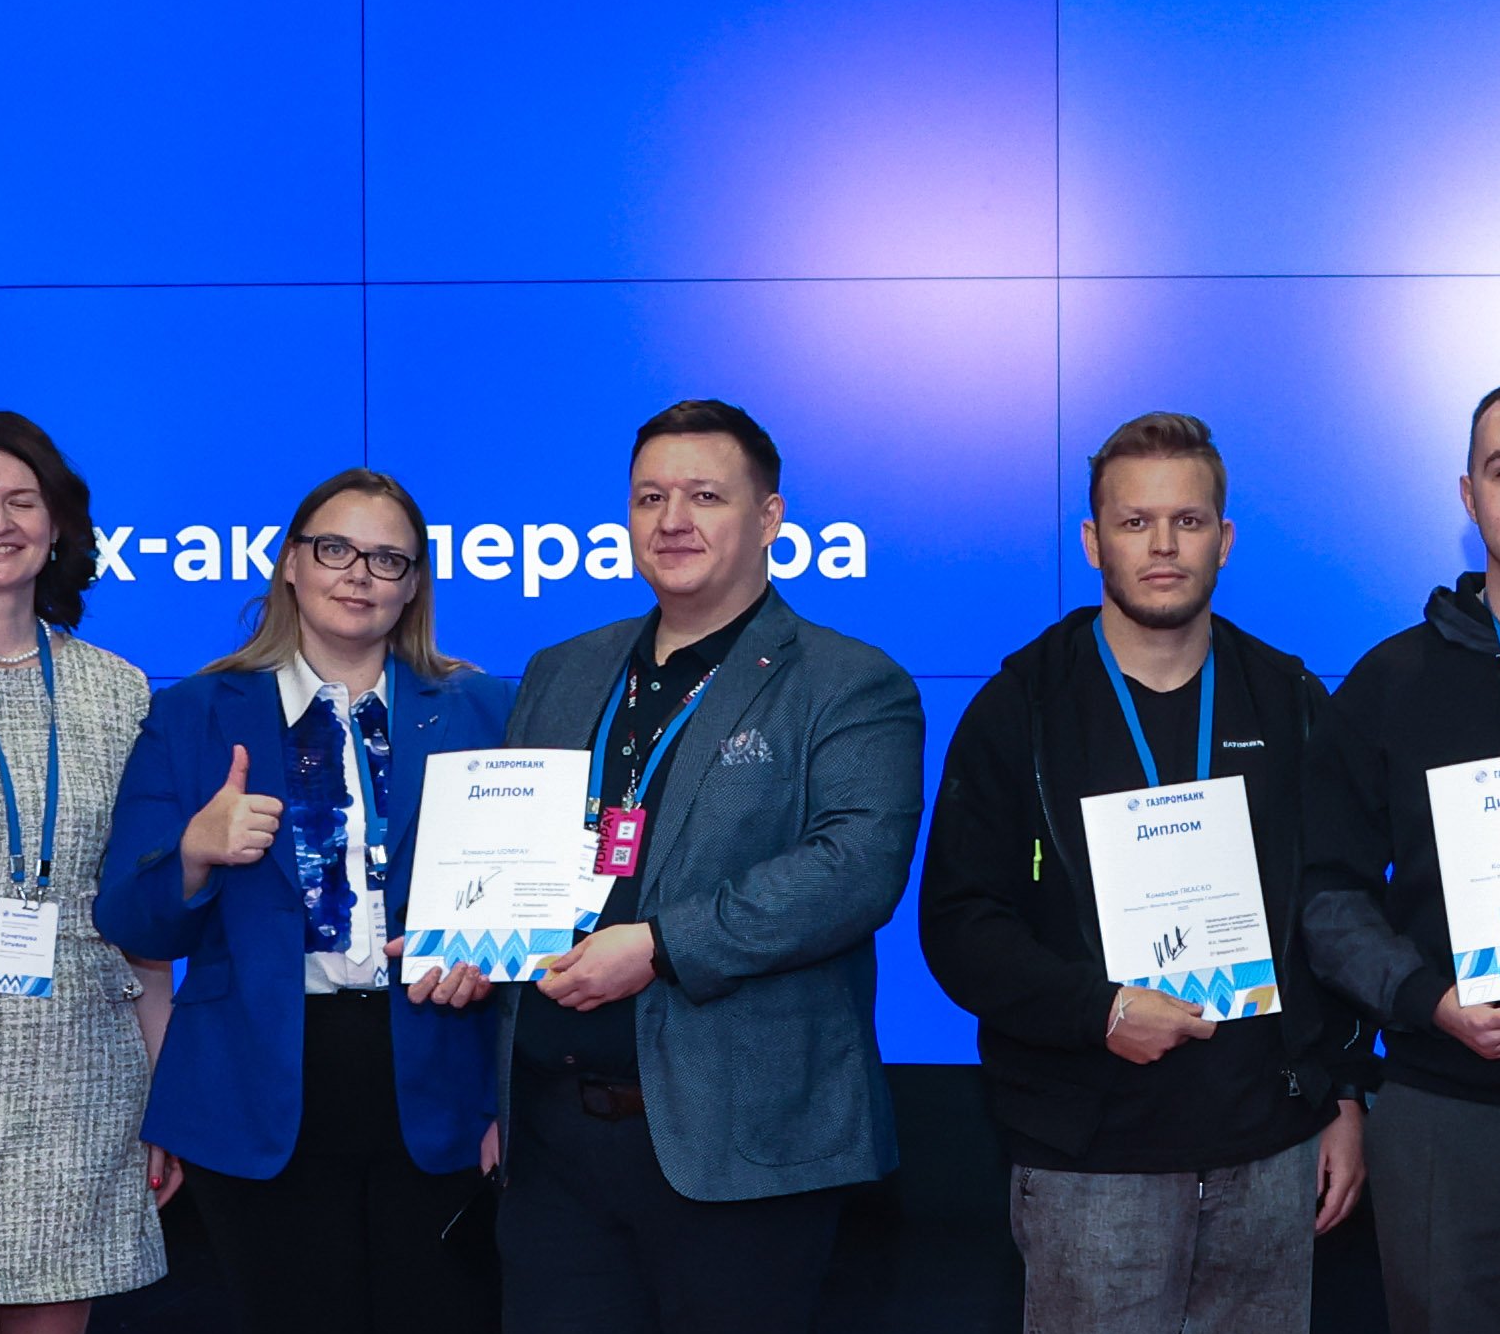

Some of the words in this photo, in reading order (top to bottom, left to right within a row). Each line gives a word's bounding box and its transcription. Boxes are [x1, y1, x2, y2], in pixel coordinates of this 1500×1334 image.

[485, 760, 545, 770] ГАЗПРОМБАНК
[468, 785, 535, 801] Диплом
[1145, 791, 1205, 808] ГАЗПРОМБАНК
[1136, 820, 1202, 841] Диплом
